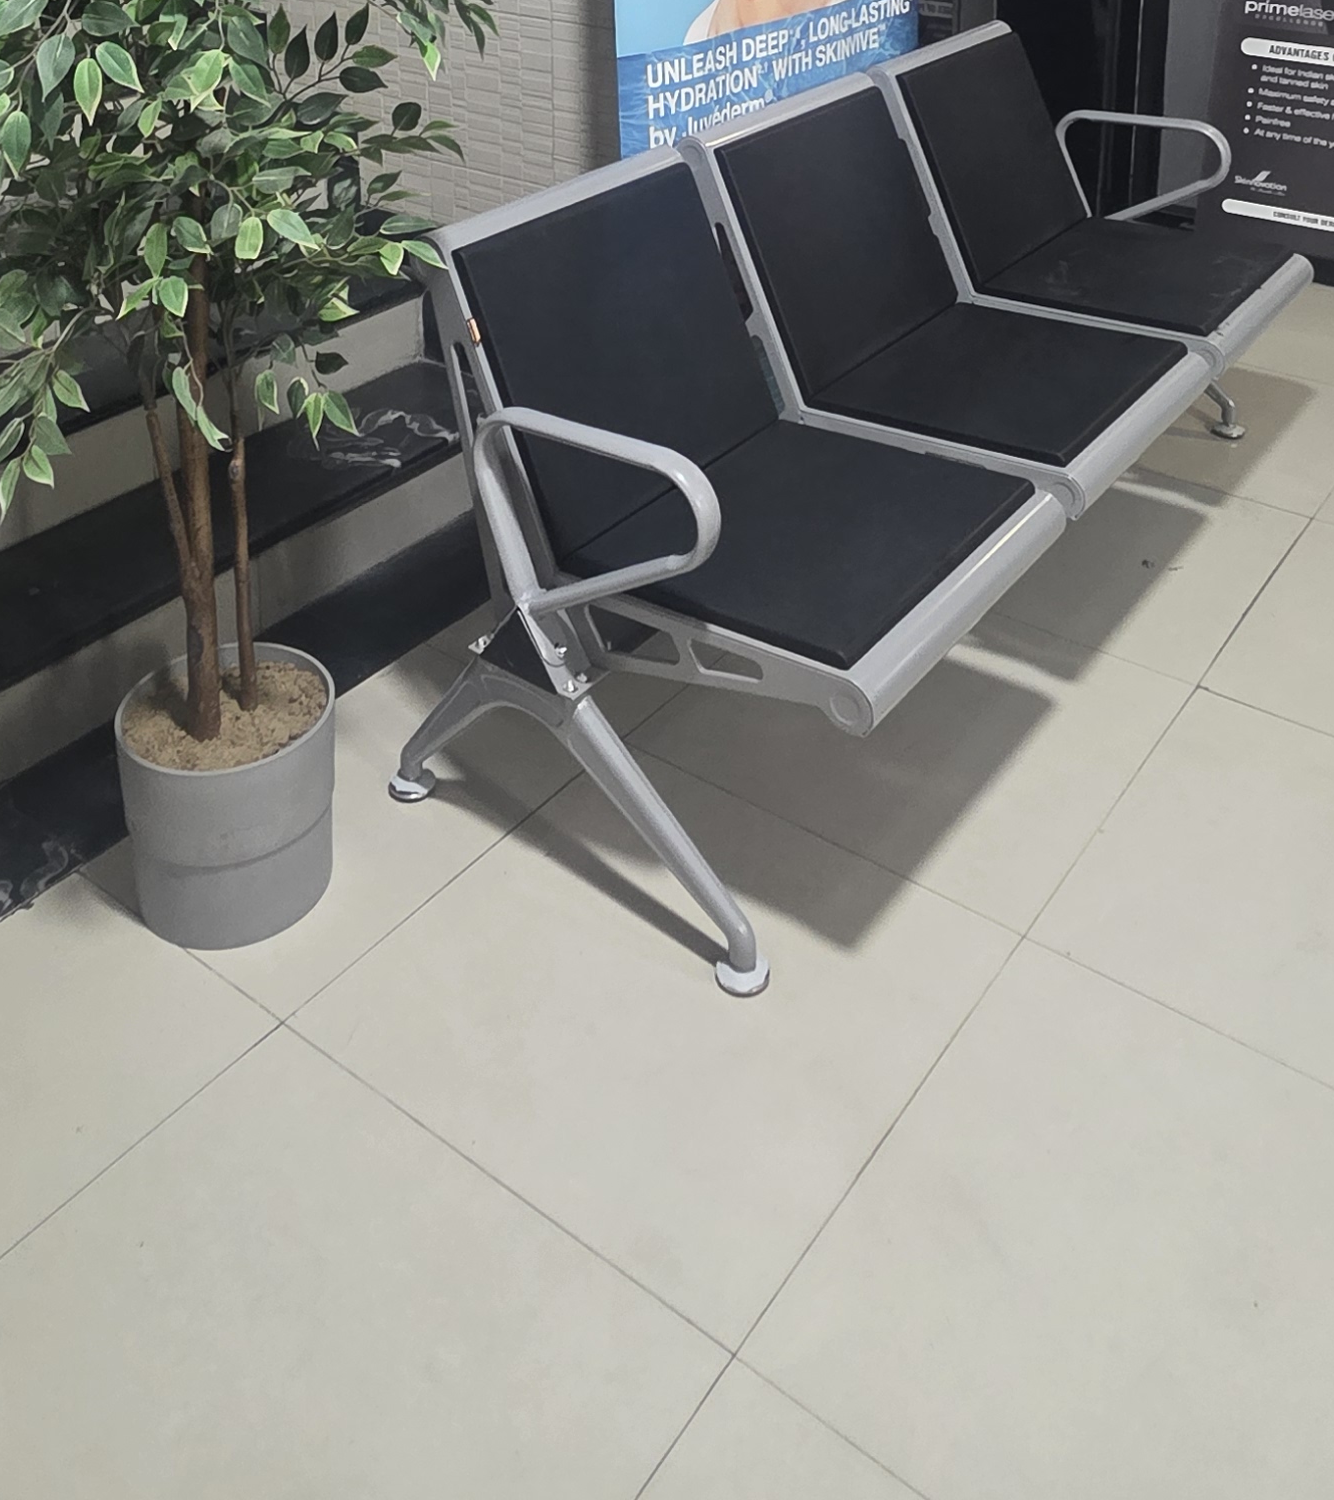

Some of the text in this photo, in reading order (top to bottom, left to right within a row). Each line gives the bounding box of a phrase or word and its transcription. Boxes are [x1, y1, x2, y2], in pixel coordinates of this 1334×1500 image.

[1268, 44, 1330, 62] ADVANTAGES
[646, 40, 738, 89] UNLEASH
[772, 48, 812, 82] WITH
[1262, 64, 1283, 75] Ideal
[1284, 66, 1297, 77] for
[1297, 69, 1324, 80] Indian
[1260, 75, 1329, 91] and tanned skin
[1258, 87, 1302, 101] Maximum
[1303, 93, 1330, 108] safety
[1256, 101, 1284, 114] Faster
[1284, 106, 1293, 115] &
[1293, 107, 1331, 121] effective
[1254, 115, 1291, 128] Painfree
[1253, 128, 1265, 137] At
[1265, 132, 1281, 143] any
[1282, 133, 1302, 144] time
[1302, 136, 1313, 146] of
[1313, 137, 1327, 148] the
[1273, 210, 1301, 223] CONSULT
[1302, 215, 1319, 226] YOUR
